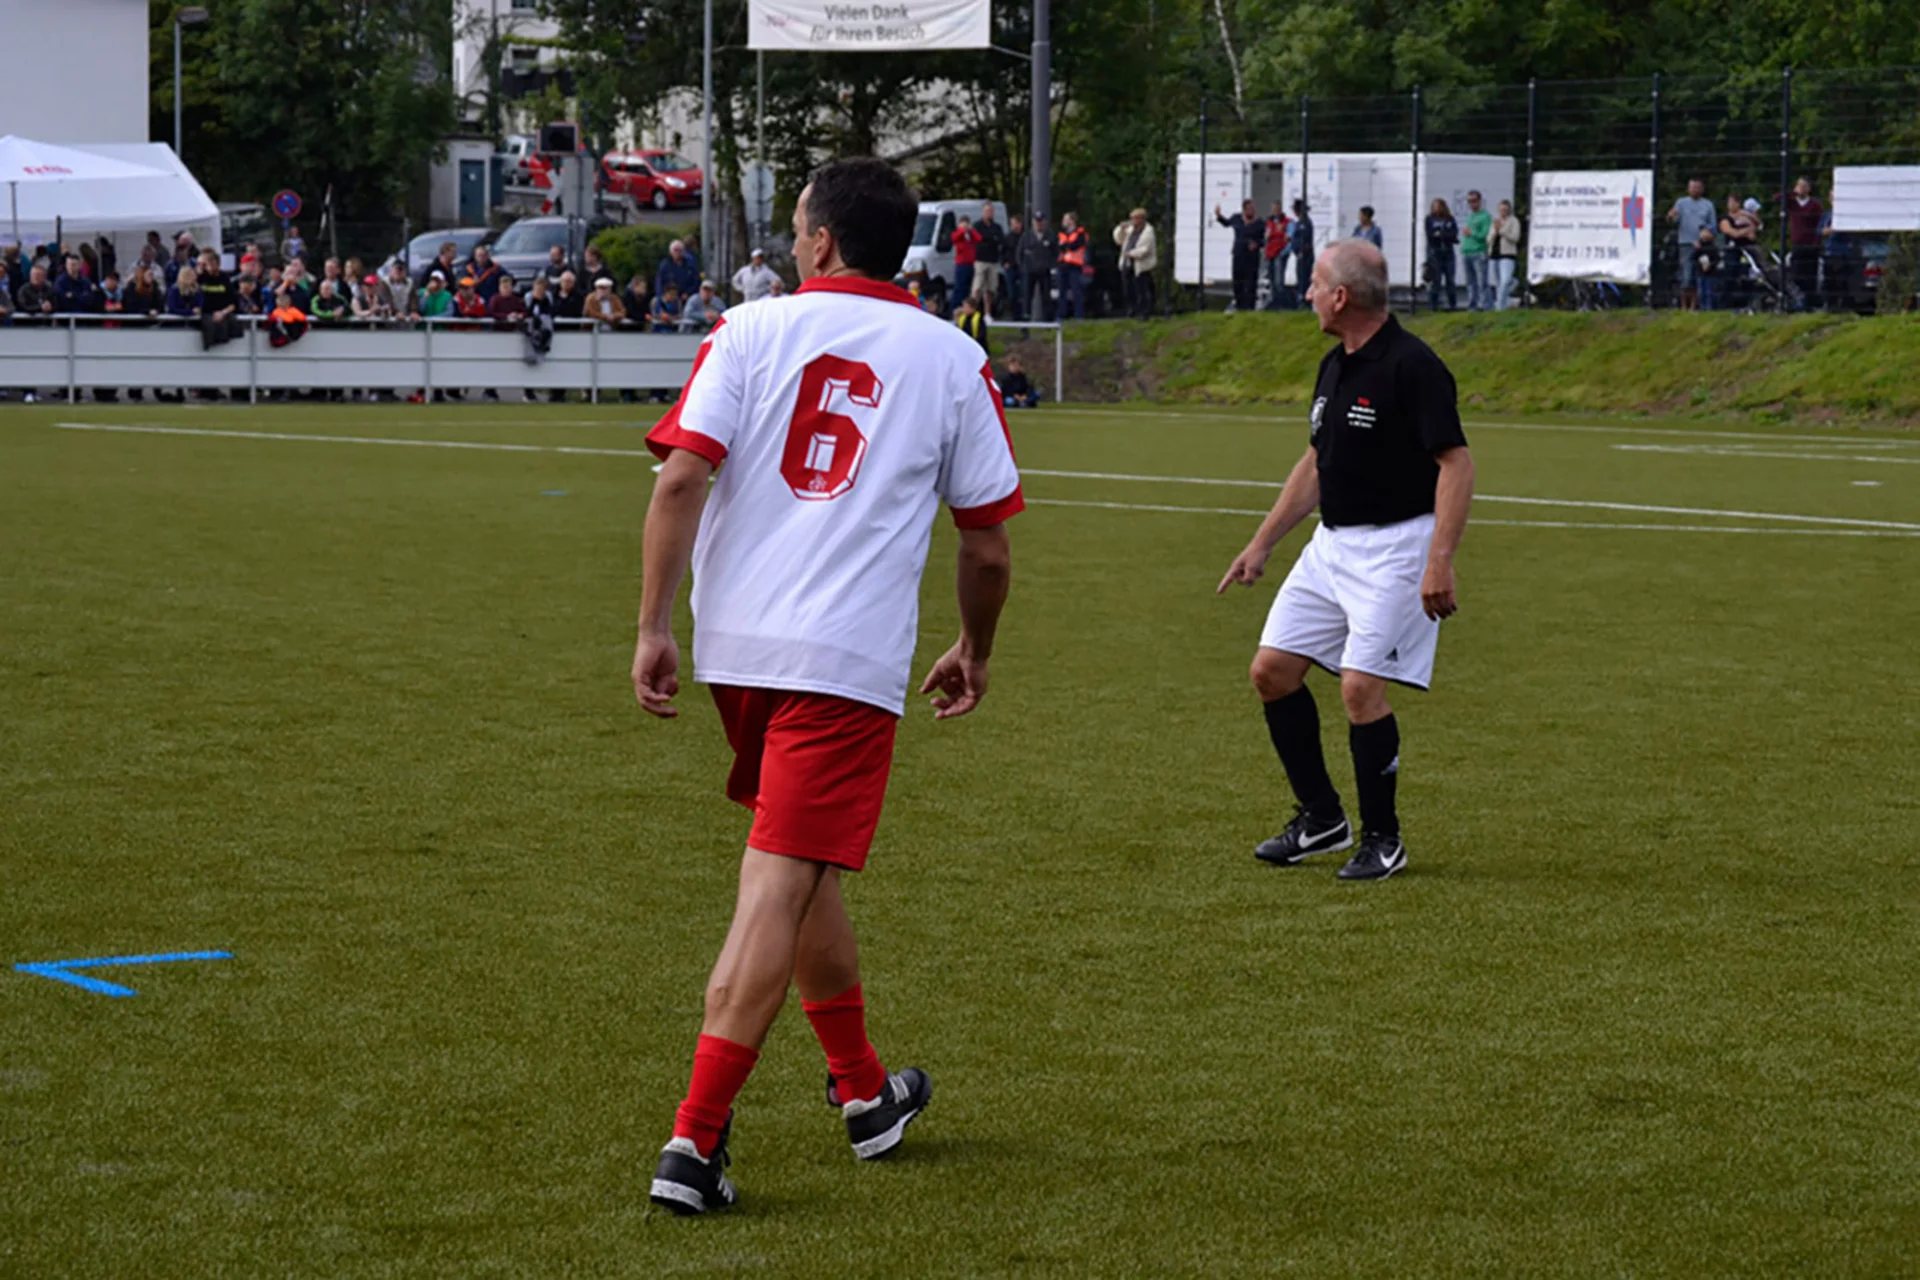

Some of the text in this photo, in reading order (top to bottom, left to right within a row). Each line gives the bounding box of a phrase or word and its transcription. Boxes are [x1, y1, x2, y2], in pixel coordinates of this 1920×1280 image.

[824, 4, 909, 21] Vielen Dank
[810, 24, 925, 42] für Ihren Besuch
[780, 353, 884, 501] 6
